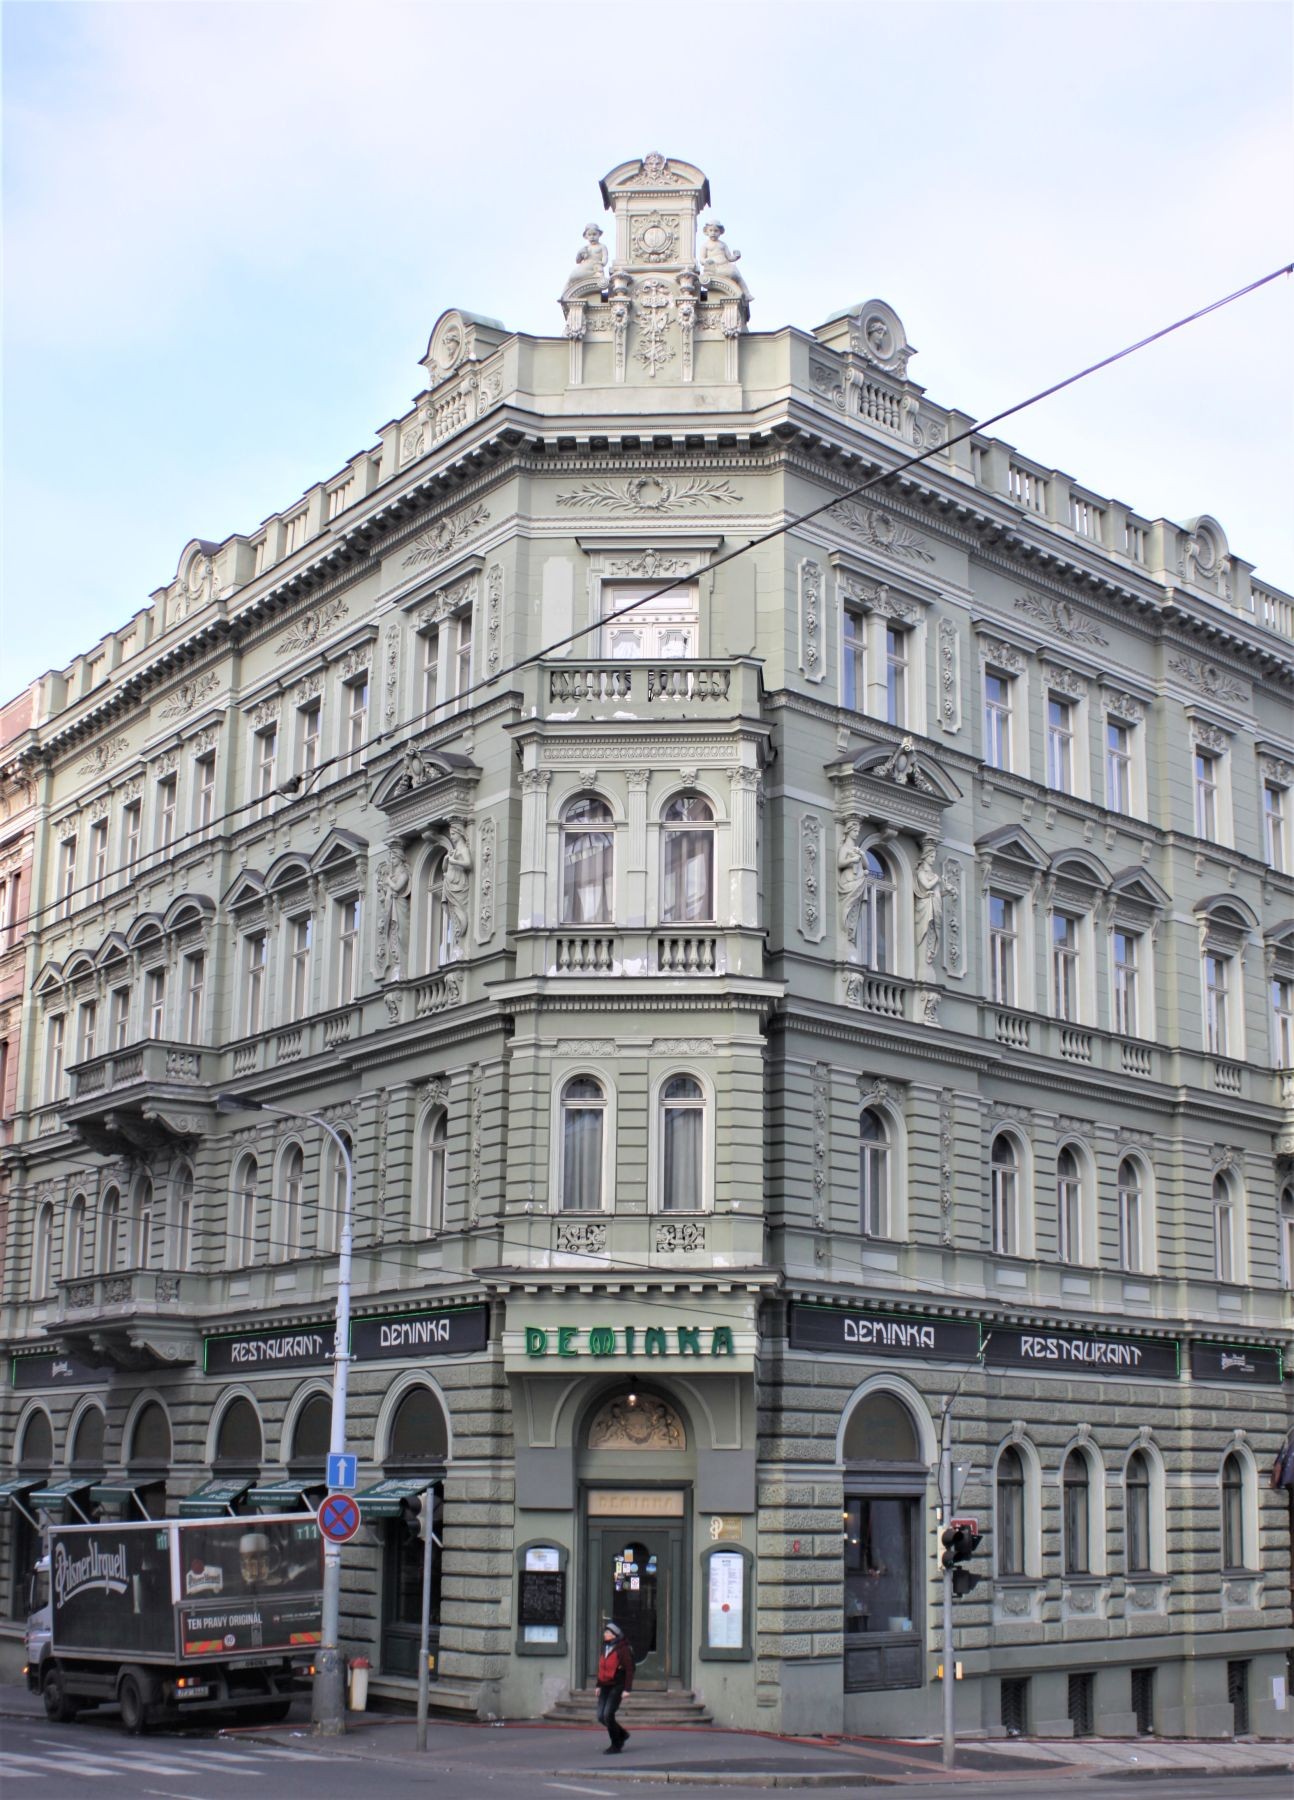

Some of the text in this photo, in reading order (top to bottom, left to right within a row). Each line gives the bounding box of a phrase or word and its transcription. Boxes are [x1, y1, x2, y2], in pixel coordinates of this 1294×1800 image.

[380, 1319, 450, 1347] DEMINKA
[525, 1326, 734, 1357] DEMINKA
[843, 1319, 935, 1348] DEMINKA
[231, 1335, 323, 1363] RESTAURANT
[1021, 1336, 1142, 1366] RESTAURANT
[55, 1537, 128, 1609] Pilsner Urquell
[187, 1618, 203, 1631] TEN
